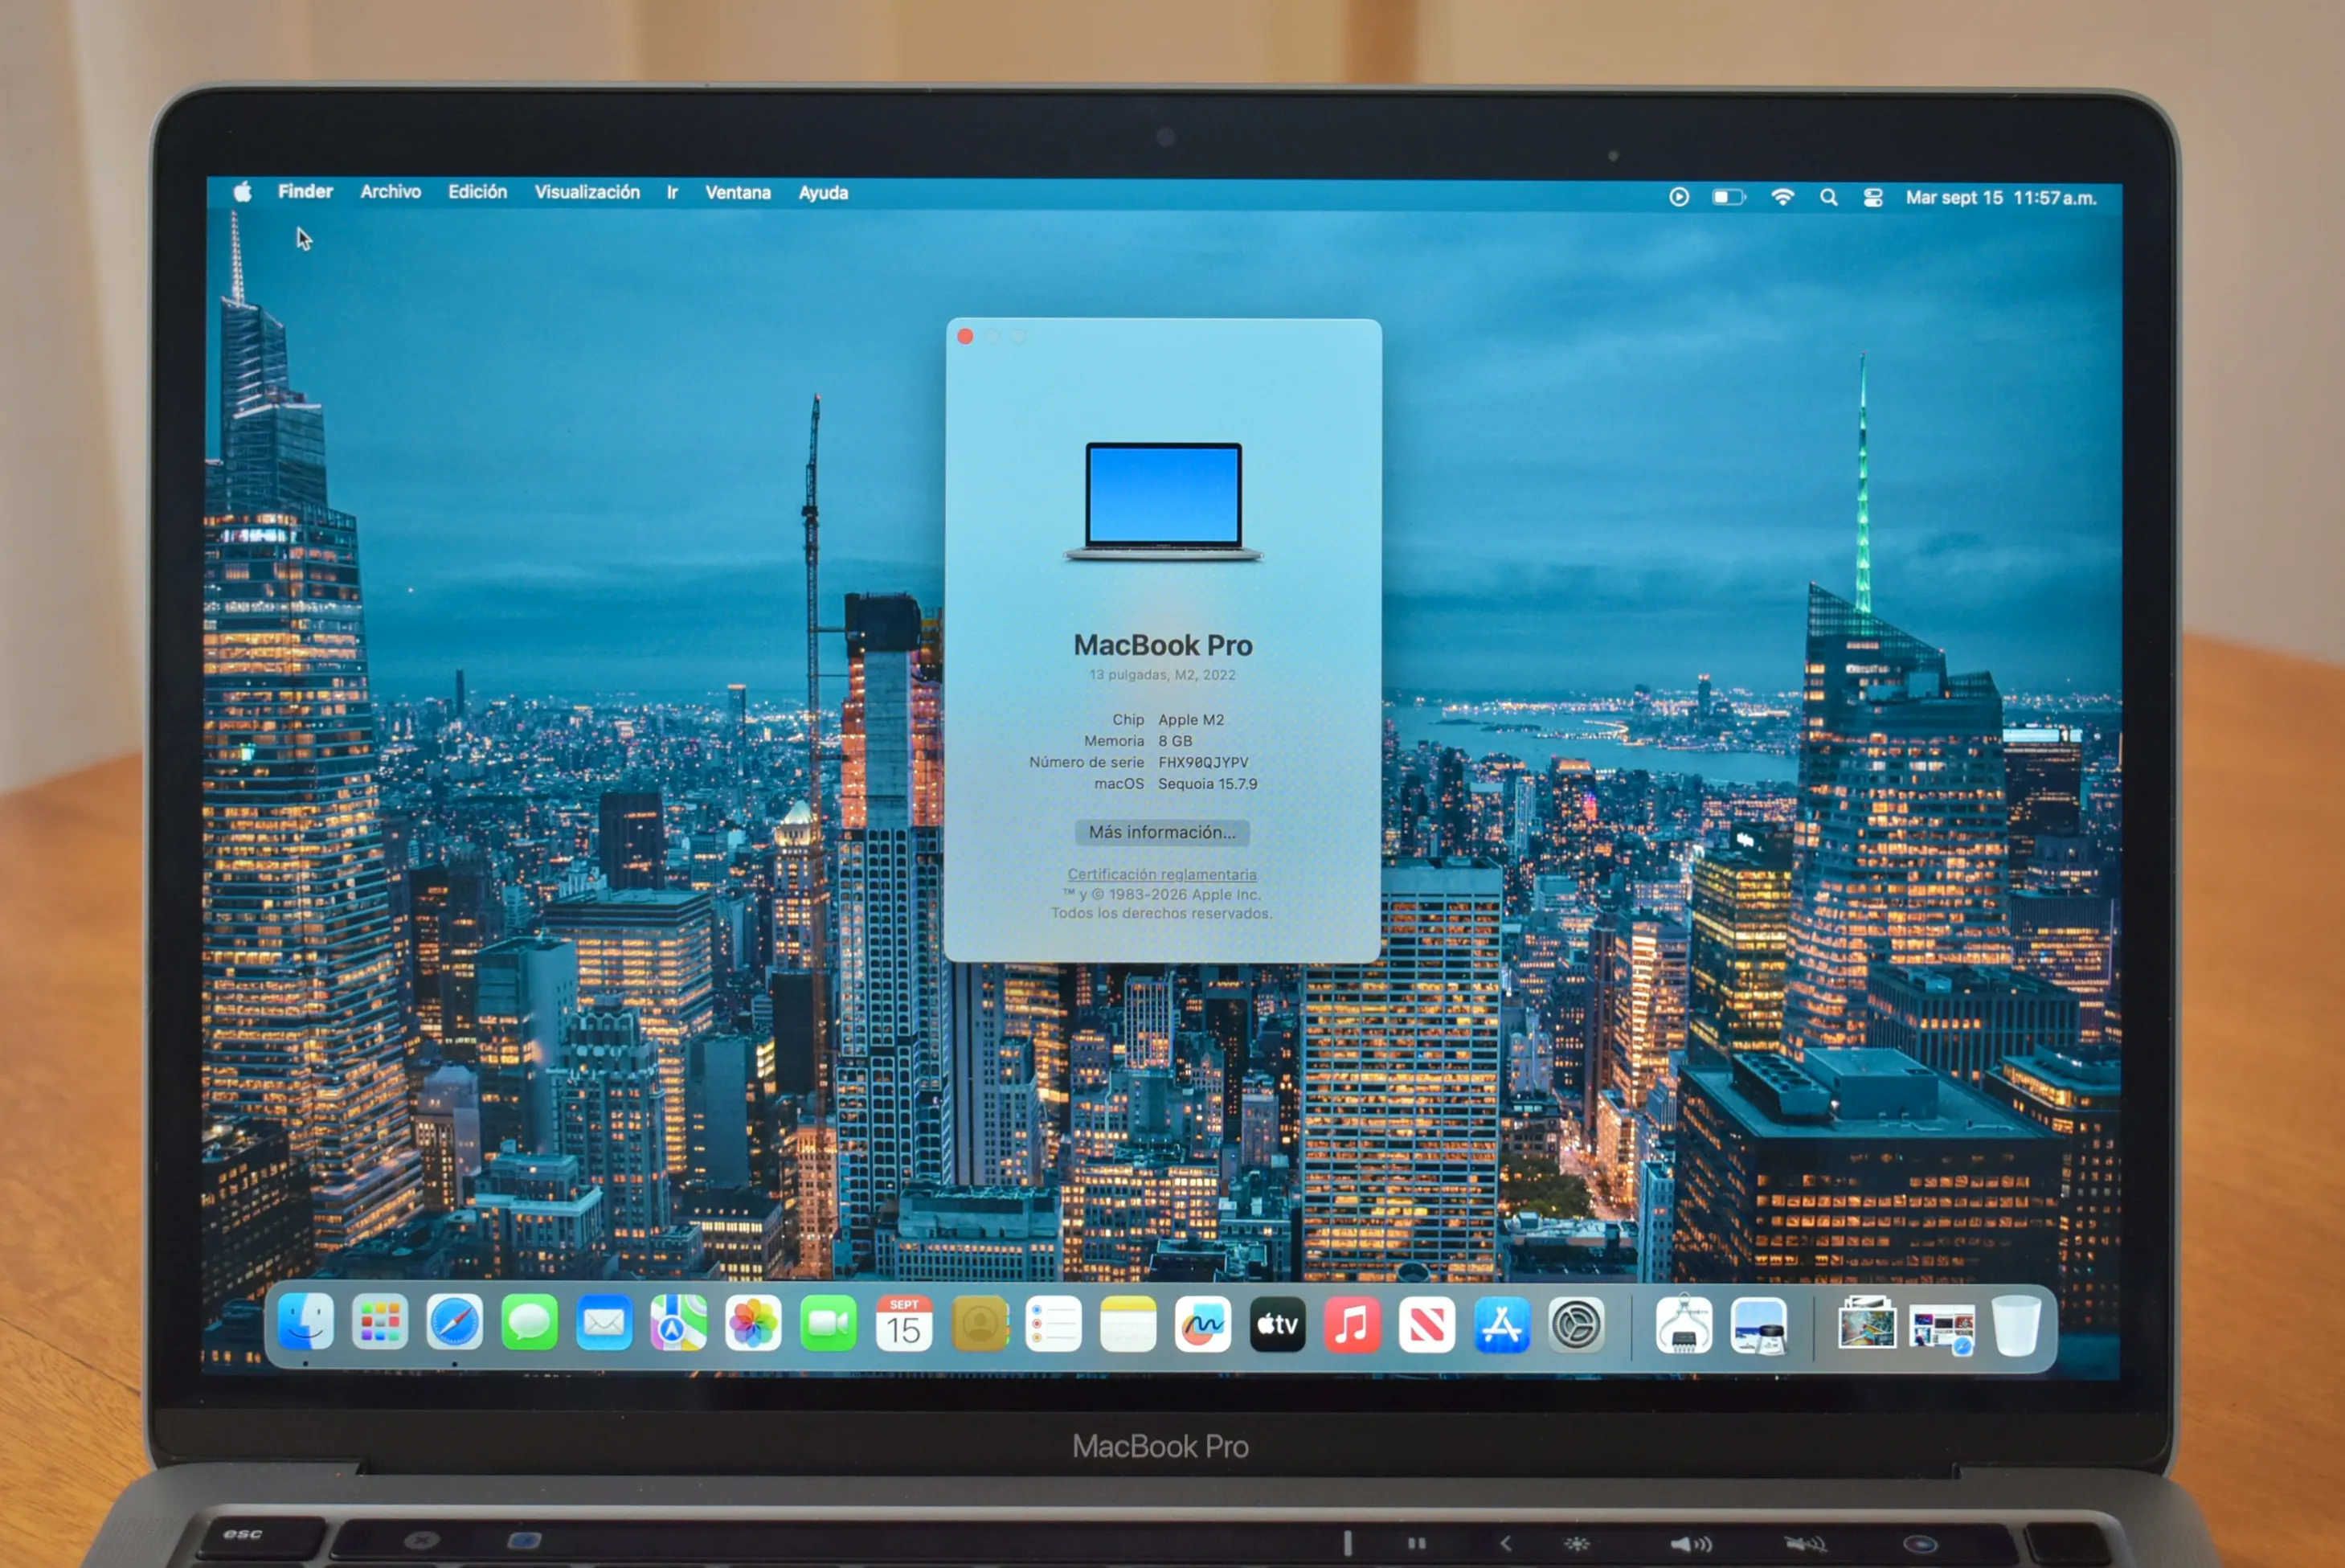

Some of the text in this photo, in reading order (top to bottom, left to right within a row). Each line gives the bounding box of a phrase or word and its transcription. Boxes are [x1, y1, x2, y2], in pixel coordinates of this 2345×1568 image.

[278, 182, 849, 203] Finder Archivo Edición Visualización Ir Ventana Ayuda
[1906, 189, 1938, 205] Mar
[1942, 190, 1979, 208] sept
[1983, 190, 2004, 206] 15
[1074, 633, 1254, 657] MacBook Pro
[1090, 668, 1236, 683] 13 pulgadas, M2, 2022
[1112, 713, 1225, 728] Chip Apple M2
[1084, 734, 1193, 747] Memoria 8 GB
[1029, 755, 1086, 768] Número
[1088, 755, 1107, 768] de
[1111, 755, 1145, 769] serie
[1095, 777, 1258, 792] macOS Sequoia 15.7.9
[1089, 824, 1123, 839] Más
[1067, 867, 1258, 883] Certificación reglamentaria
[1078, 890, 1088, 903] y
[1109, 887, 1188, 901] 1983-2026
[1192, 888, 1233, 903] Apple
[1236, 888, 1262, 901] Inc.
[1050, 906, 1274, 920] Todos los derechos reservados.
[890, 1299, 919, 1310] SEPT
[886, 1316, 921, 1345] 15
[1073, 1433, 1250, 1459] MacBook Pro
[222, 1529, 264, 1541] esc
